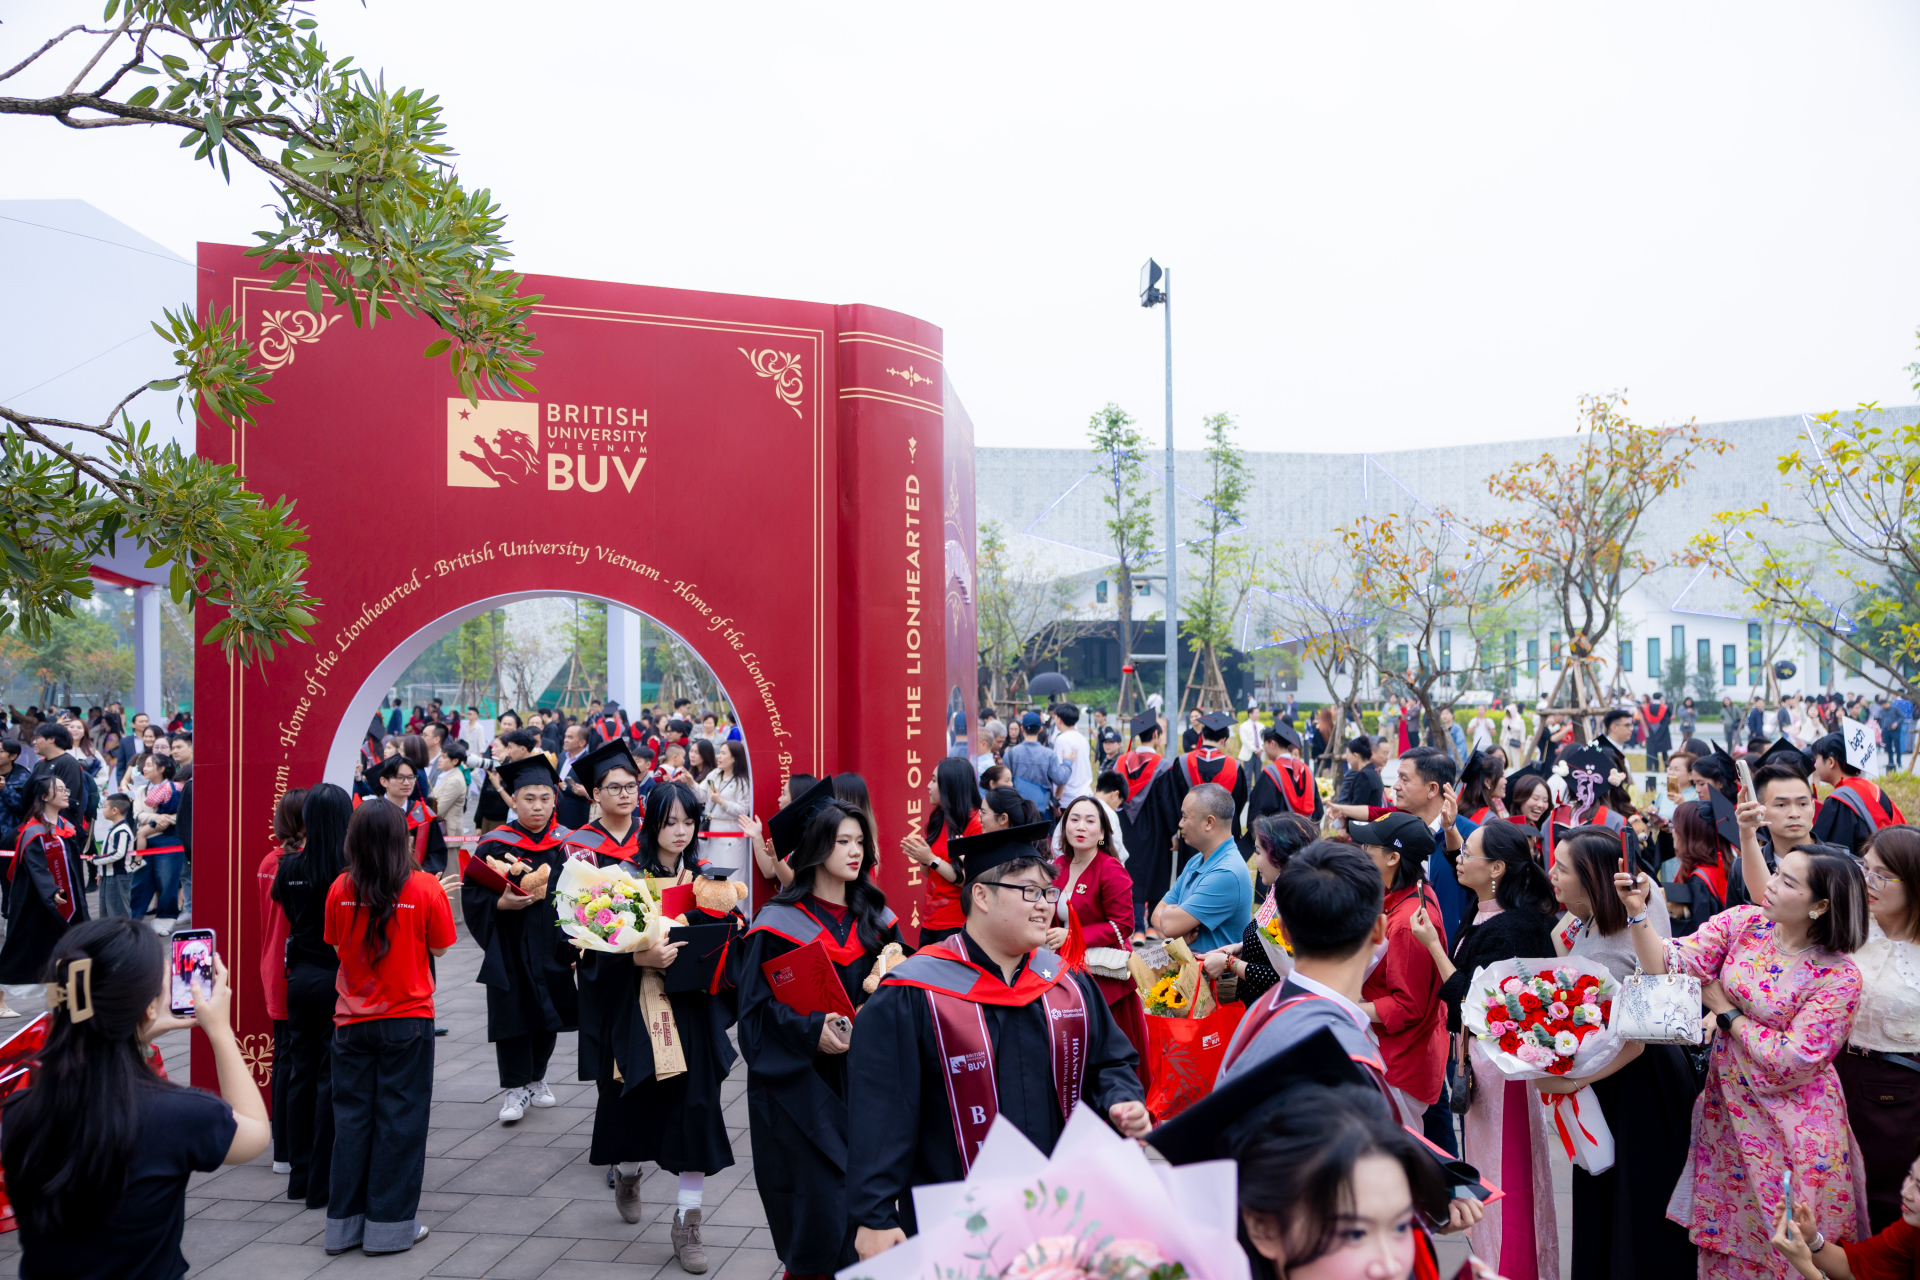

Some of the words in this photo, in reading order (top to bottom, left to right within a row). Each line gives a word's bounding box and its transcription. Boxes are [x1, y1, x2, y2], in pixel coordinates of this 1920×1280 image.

[547, 403, 648, 427] BRITISH
[547, 426, 647, 443] UNIVERSITY
[548, 441, 648, 454] VIETNAM
[547, 453, 648, 494] BUV
[434, 541, 495, 577] British
[498, 539, 590, 565] University
[595, 545, 661, 581] Vietnam
[906, 474, 921, 674] LIONHEARTED
[335, 568, 422, 653] Lionhearted
[672, 580, 713, 616] Home
[707, 617, 734, 632] of
[723, 627, 745, 651] the
[314, 652, 340, 677] the
[304, 669, 327, 697] of
[739, 652, 792, 744] Lionhearted
[279, 697, 312, 747] Home
[907, 686, 922, 740] THE
[778, 751, 793, 794] Brit
[907, 749, 922, 789] OF
[967, 1060, 986, 1072] BUV
[1061, 1030, 1069, 1085] INTERNATIONAL
[969, 1105, 987, 1125] B
